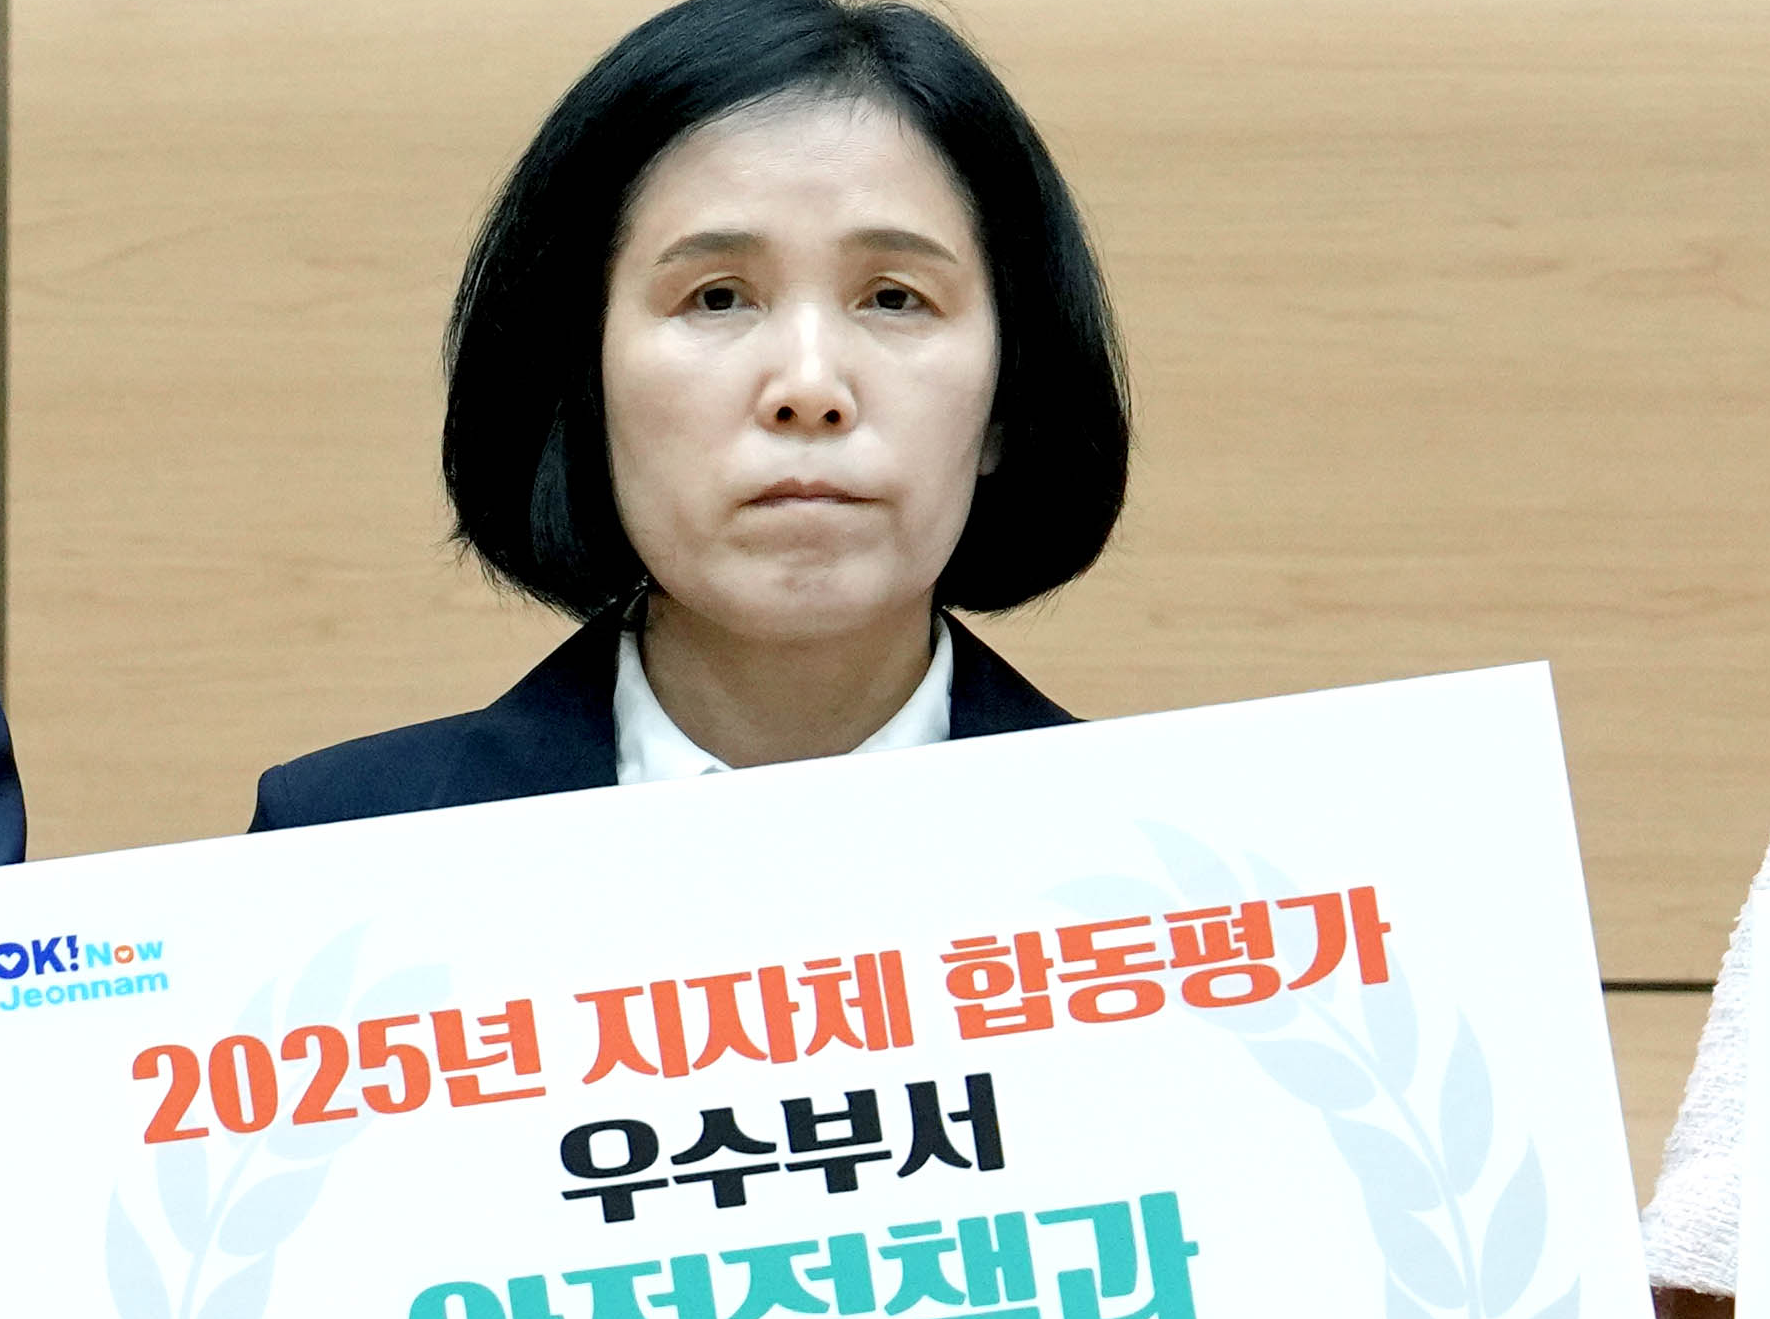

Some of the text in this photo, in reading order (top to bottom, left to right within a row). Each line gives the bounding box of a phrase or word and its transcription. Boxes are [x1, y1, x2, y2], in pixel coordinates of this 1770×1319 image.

[86, 942, 162, 967] Now
[133, 886, 1390, 1144] 2025년 지자체 합동평가
[560, 1073, 1004, 1223] 우수부서
